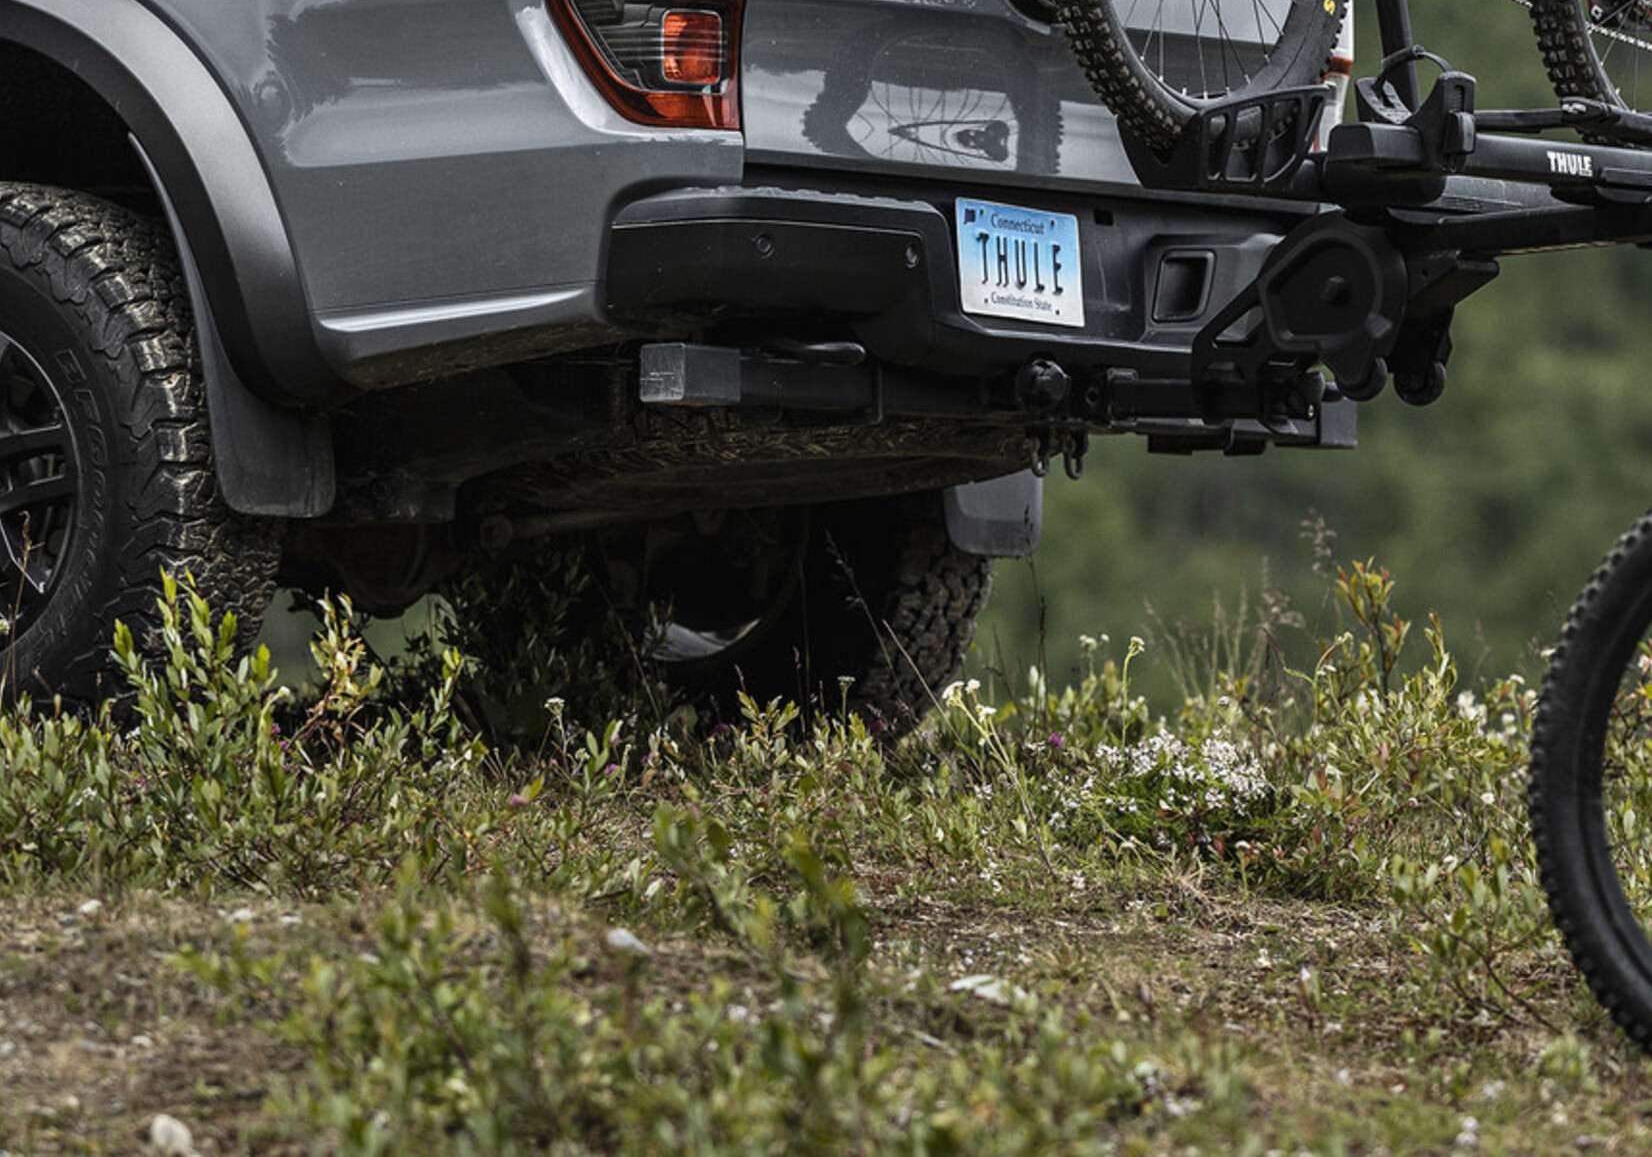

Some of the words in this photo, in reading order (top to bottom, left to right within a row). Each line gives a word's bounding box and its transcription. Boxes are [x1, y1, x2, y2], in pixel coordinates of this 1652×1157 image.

[1546, 150, 1593, 177] THULE
[990, 213, 1045, 235] Connecticut
[976, 232, 1065, 295] THULE
[991, 291, 1034, 309] Constitution
[1034, 297, 1053, 313] State
